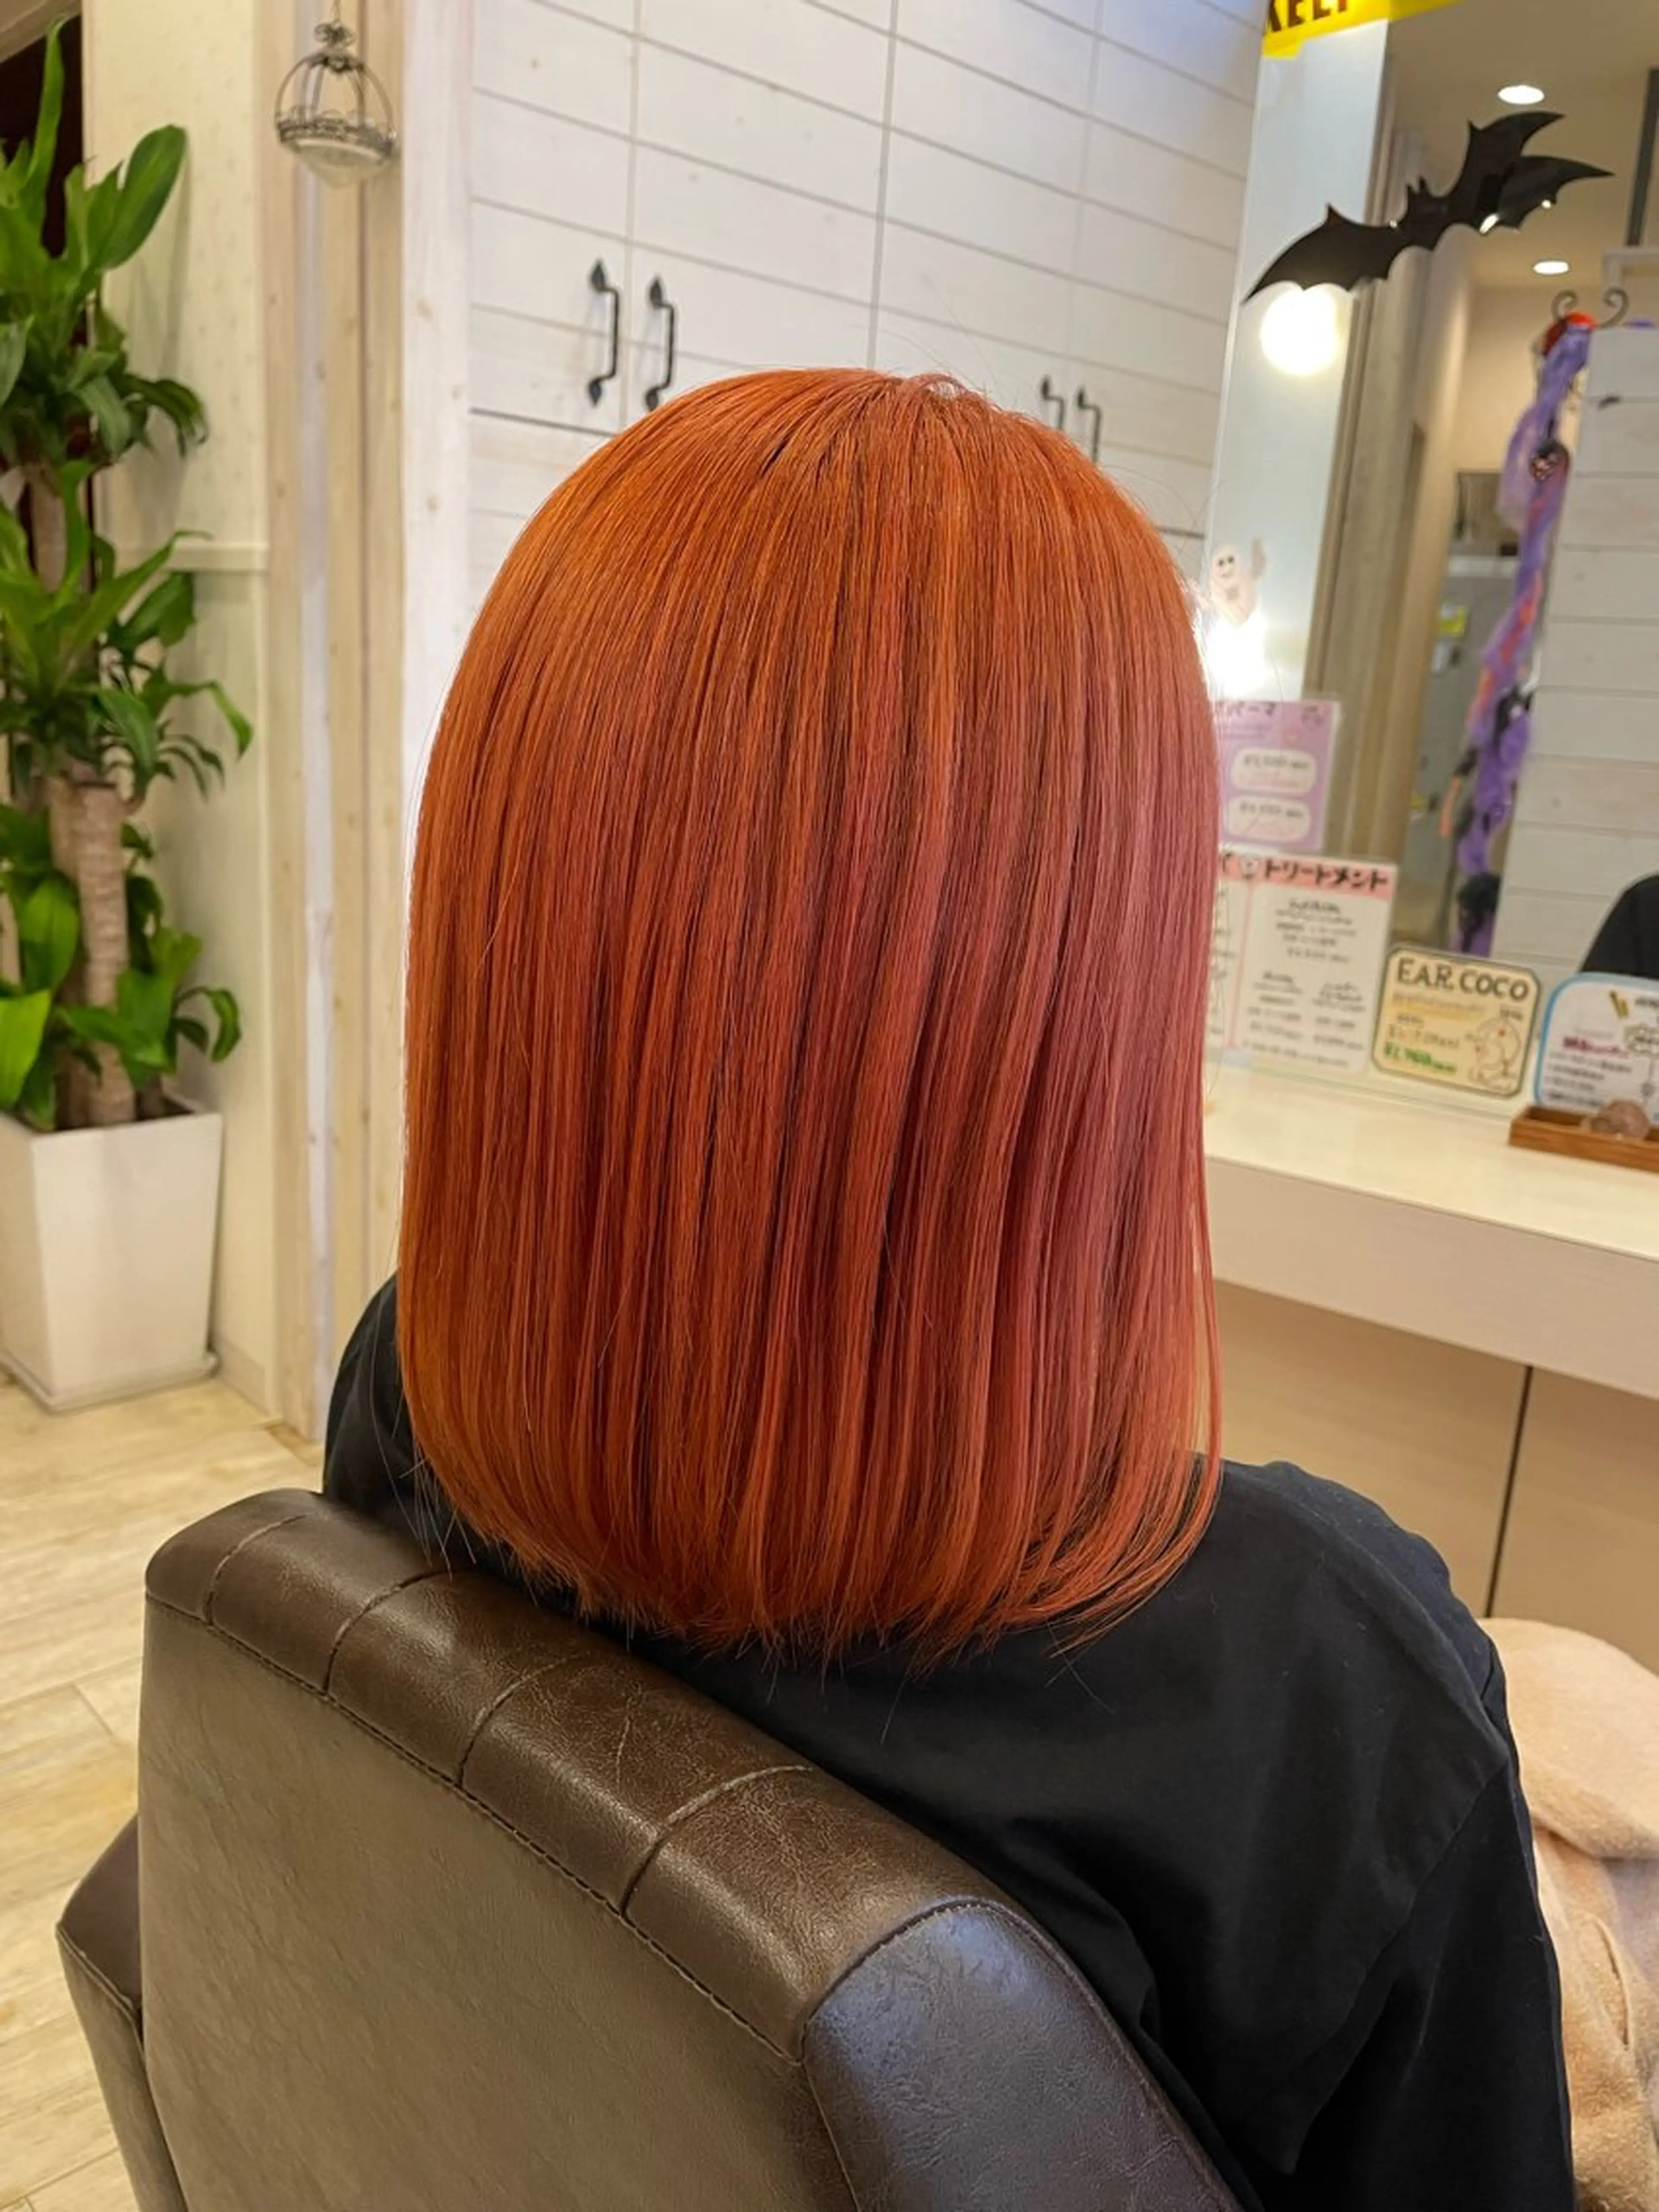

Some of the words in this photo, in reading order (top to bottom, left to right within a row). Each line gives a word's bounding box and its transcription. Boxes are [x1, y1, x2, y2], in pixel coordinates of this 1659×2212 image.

[1264, 858, 1389, 891] トリートメント
